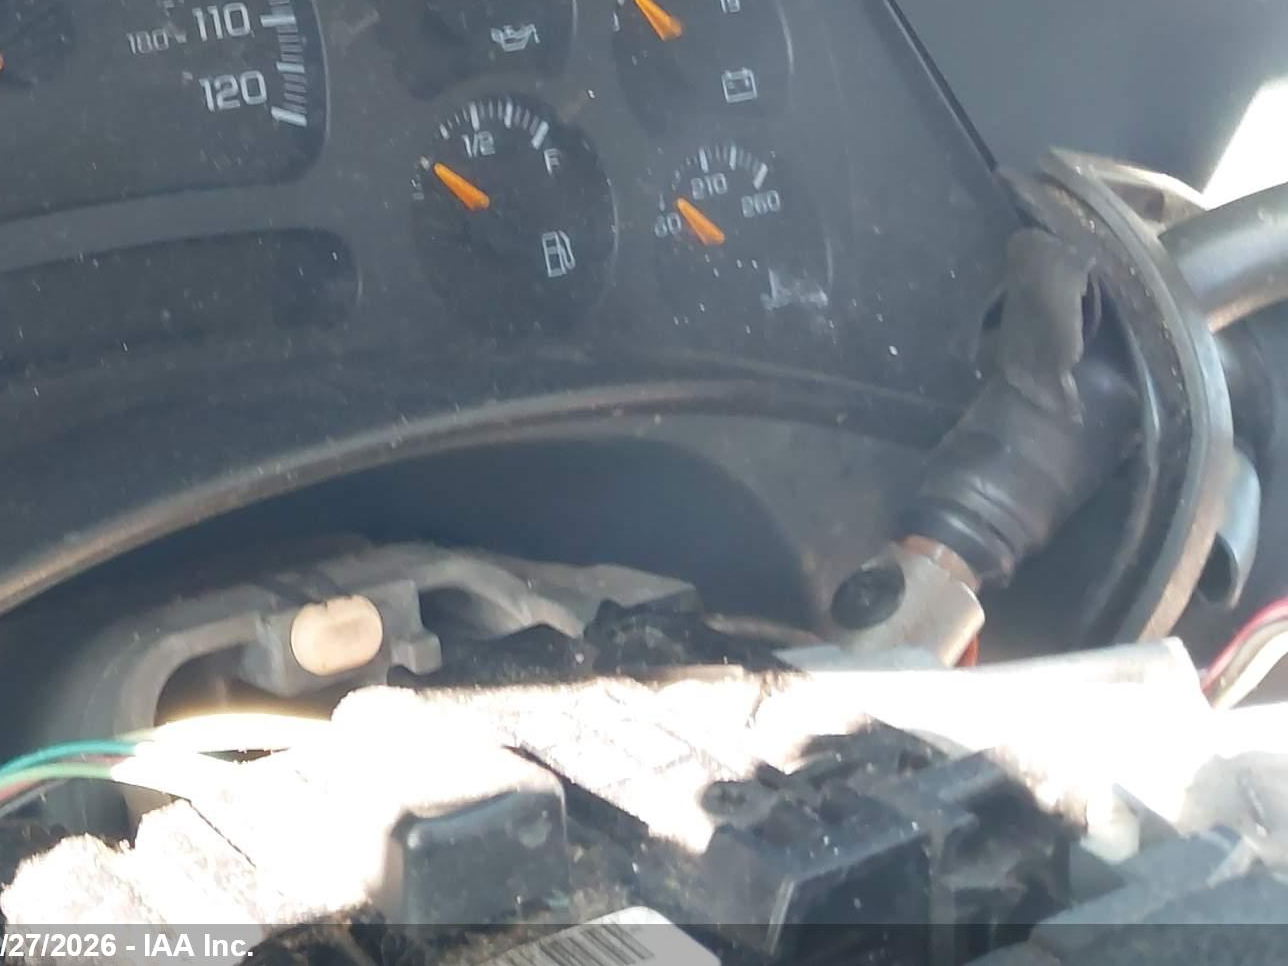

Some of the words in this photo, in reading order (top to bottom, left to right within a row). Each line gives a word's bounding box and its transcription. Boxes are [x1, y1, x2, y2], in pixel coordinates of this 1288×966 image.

[193, 3, 252, 41] 110
[199, 71, 268, 112] 120
[544, 148, 561, 175] F
